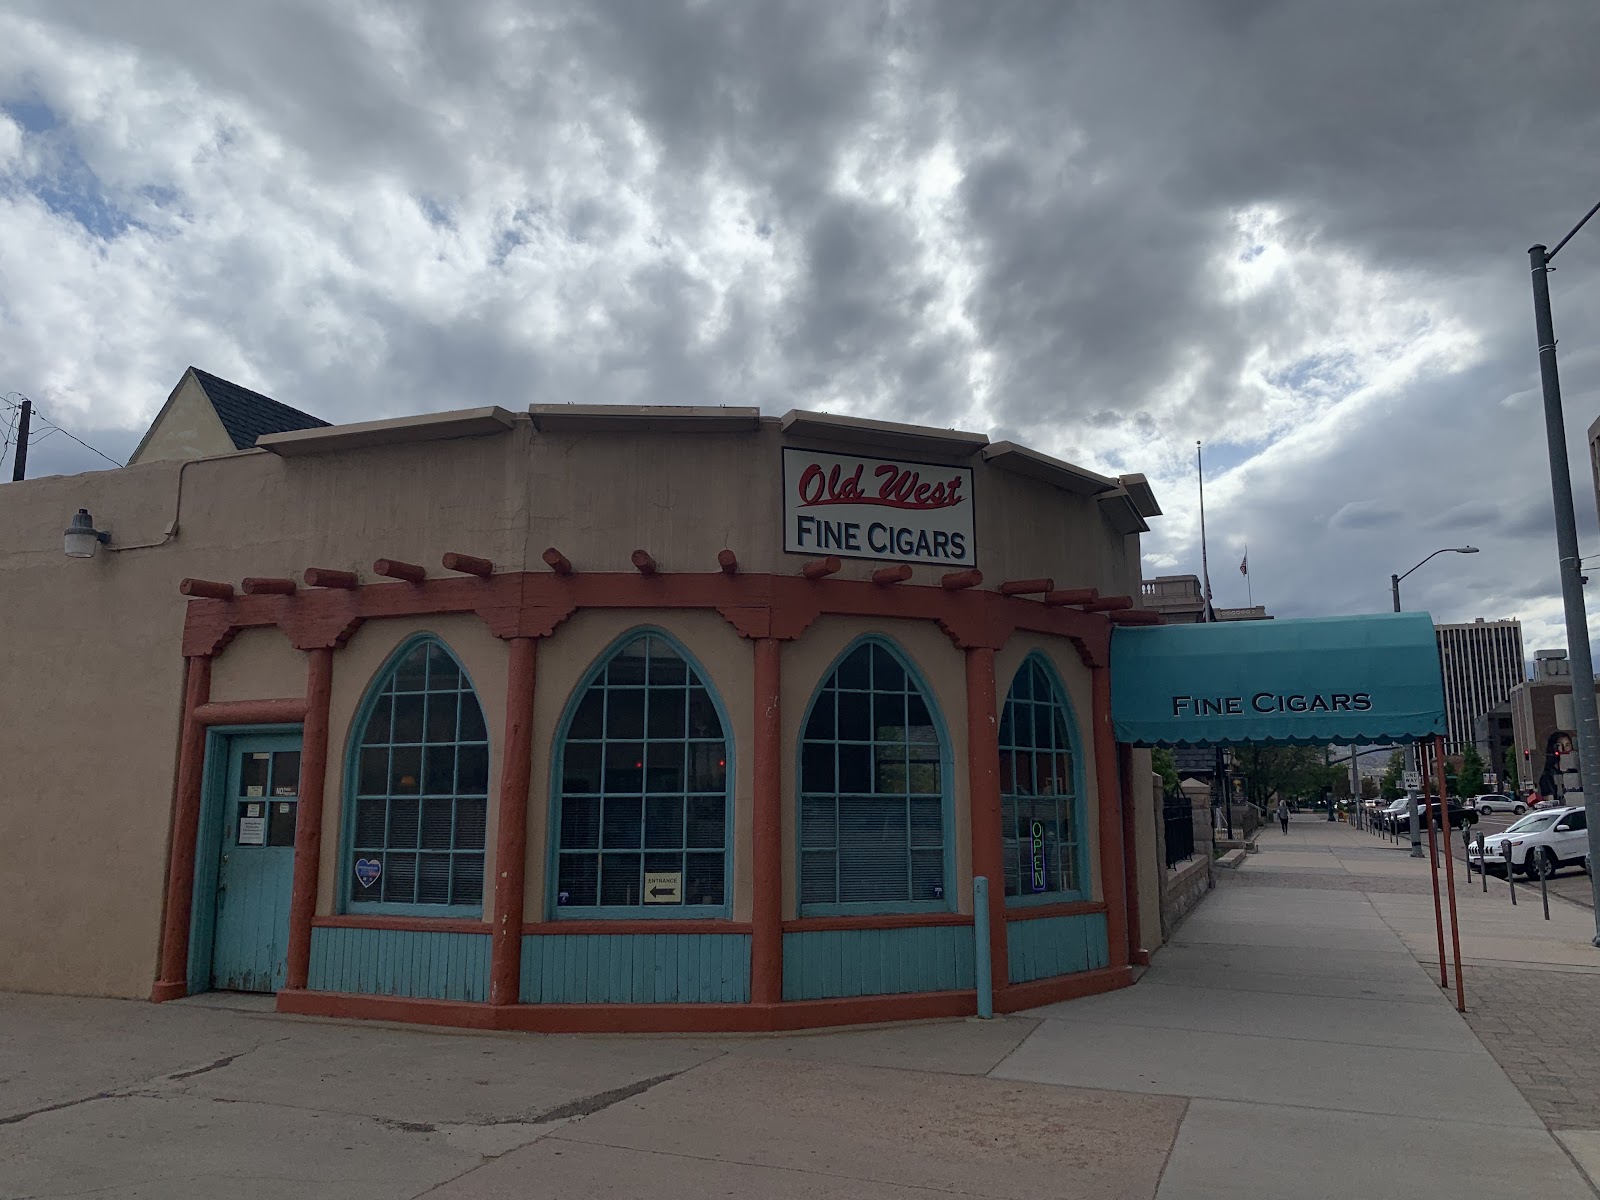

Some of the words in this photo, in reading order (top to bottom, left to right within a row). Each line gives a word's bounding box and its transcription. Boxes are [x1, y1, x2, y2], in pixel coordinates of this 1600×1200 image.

[799, 463, 865, 504] Old
[875, 464, 964, 505] West
[796, 515, 862, 551] FINE
[867, 522, 967, 560] CIGARS
[1172, 695, 1244, 717] FINE
[1252, 692, 1373, 713] CIGARS
[276, 787, 284, 795] NO
[1032, 822, 1043, 886] OPEN
